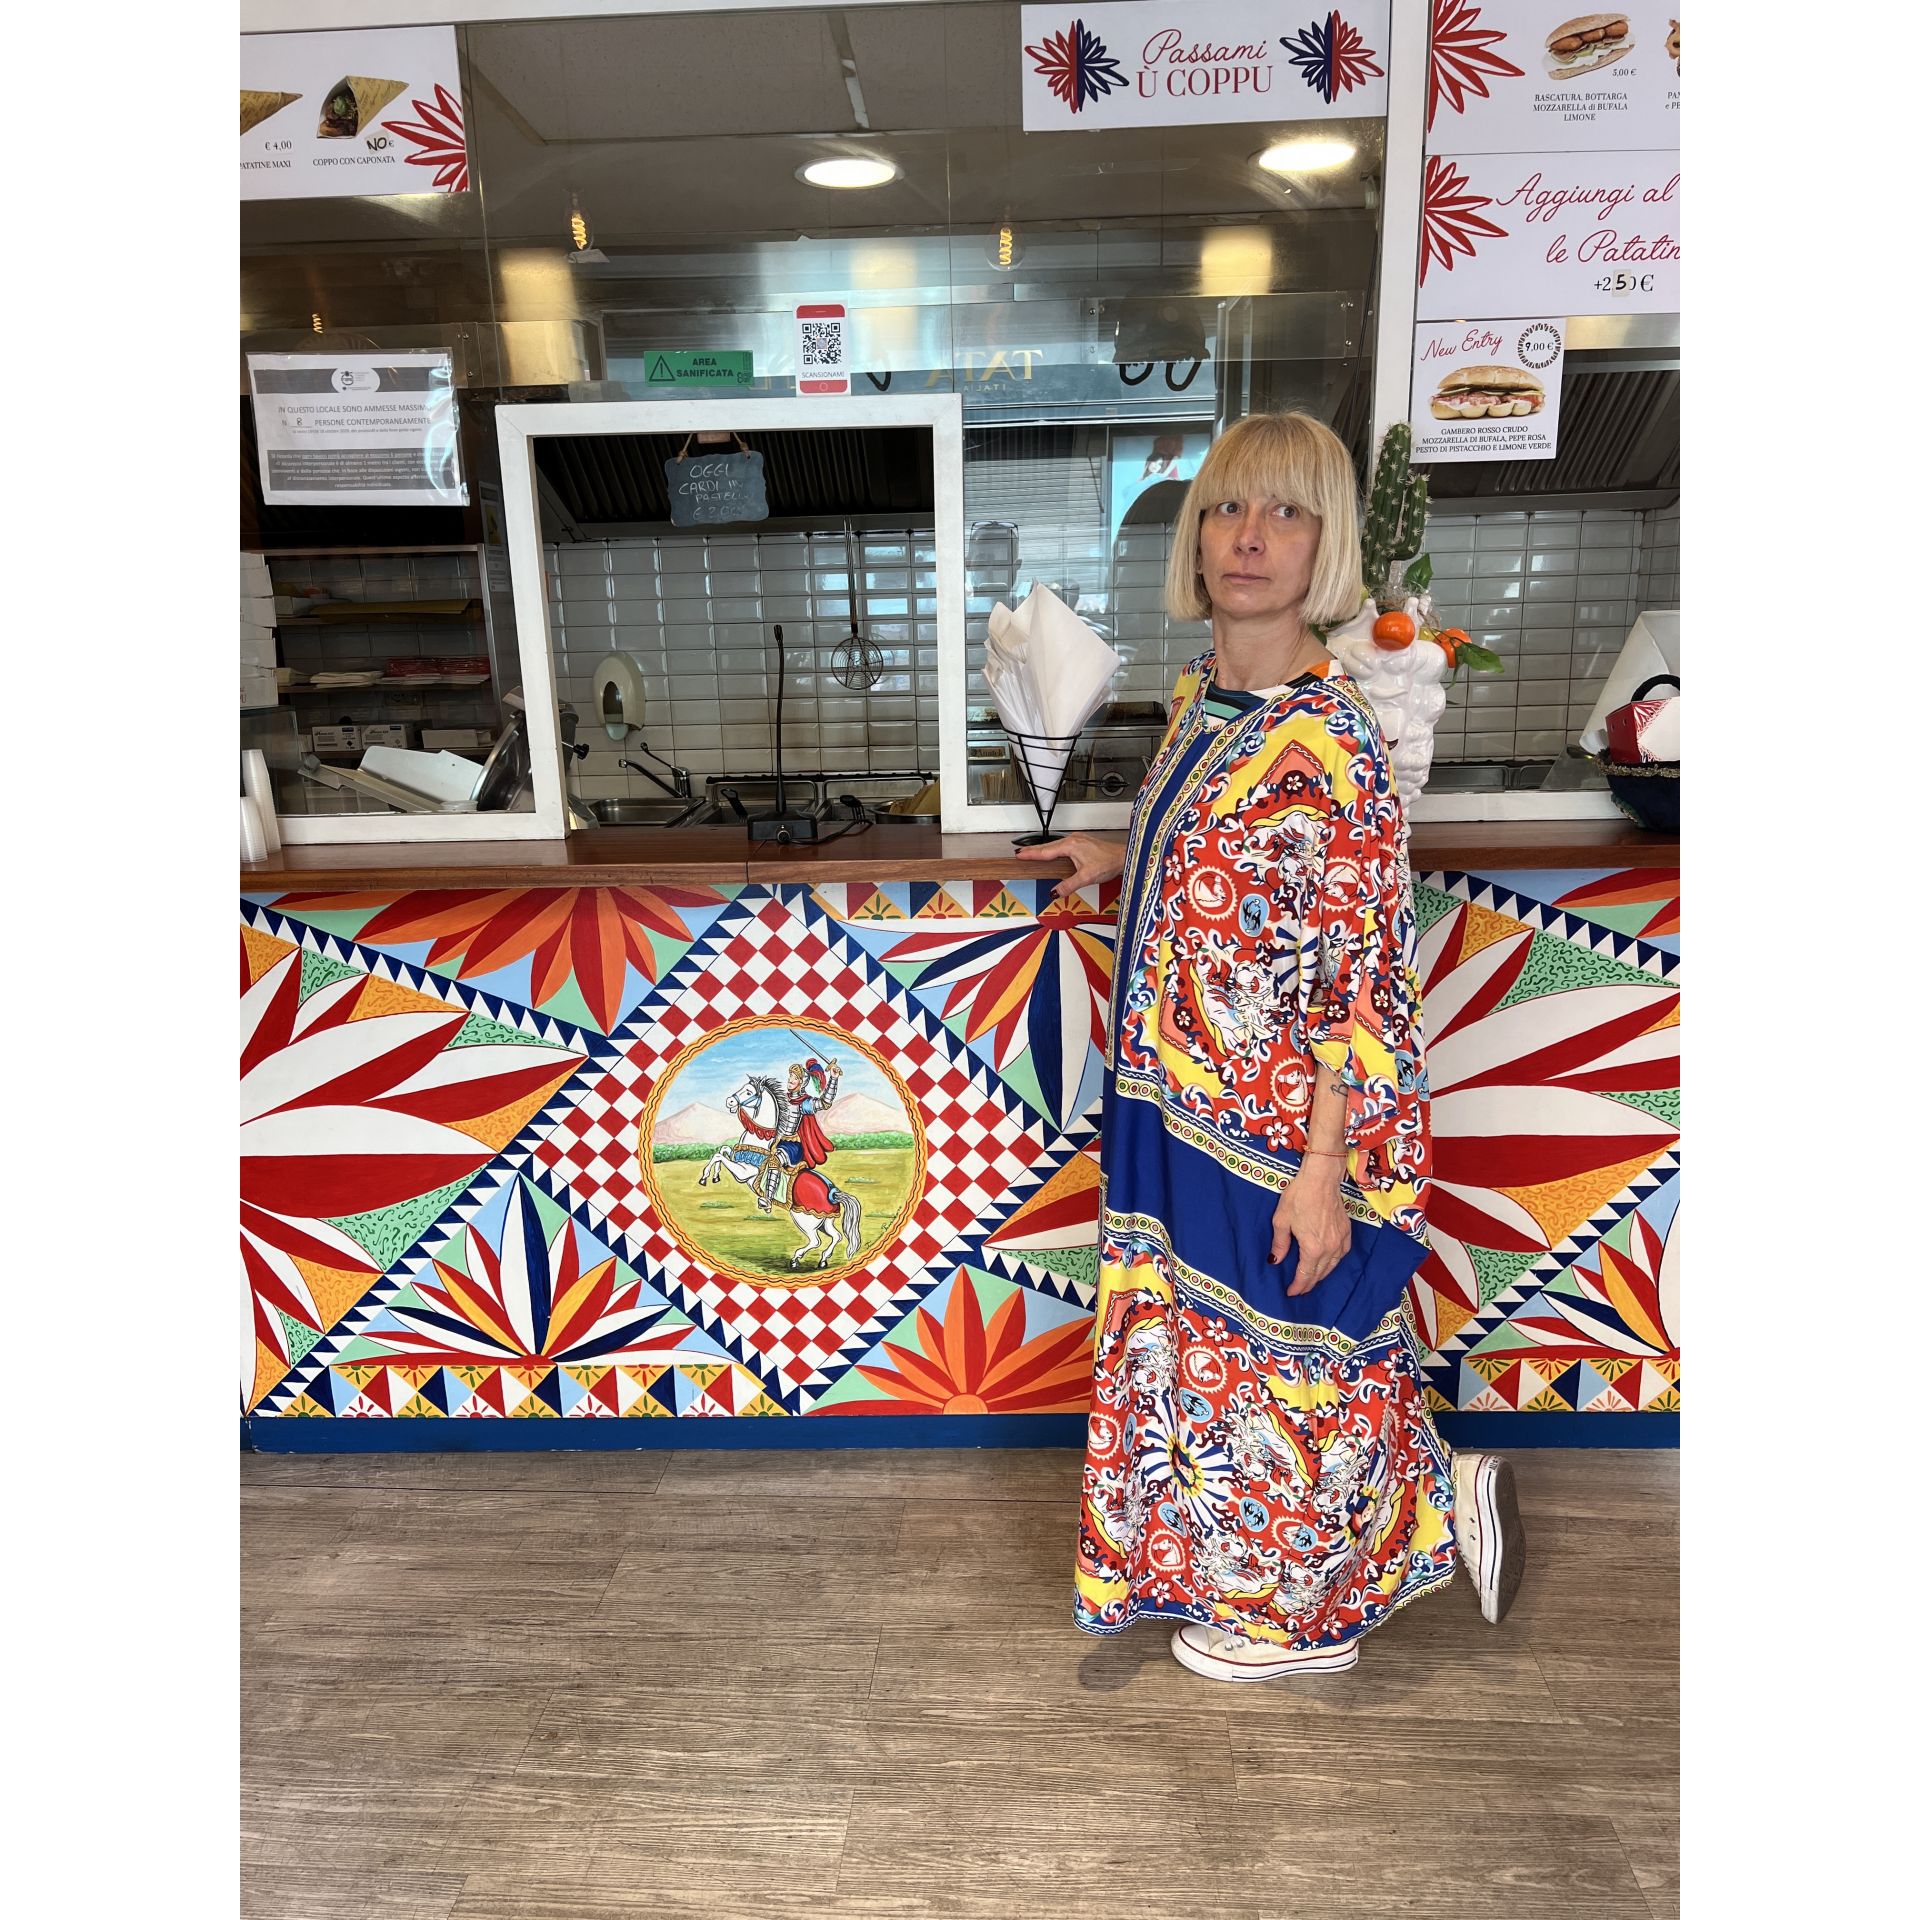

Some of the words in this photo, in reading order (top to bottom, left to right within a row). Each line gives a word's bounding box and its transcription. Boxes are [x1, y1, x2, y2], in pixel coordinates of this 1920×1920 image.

[1142, 28, 1267, 66] Passami
[1612, 68, 1629, 77] 5,00
[1136, 65, 1158, 98] Ù
[1166, 65, 1274, 97] COPPU
[1585, 92, 1628, 101] BOTTARGA
[1533, 104, 1587, 112] MOZZARELLA
[1588, 103, 1596, 111] di
[1597, 103, 1628, 111] BUFALA
[1563, 113, 1596, 122] LIMONE
[265, 141, 271, 151] €
[273, 140, 292, 151] 4,00
[366, 136, 387, 151] NO
[272, 160, 292, 169] MAXI
[312, 158, 338, 167] COPPO
[339, 157, 356, 166] CON
[357, 155, 396, 165] CAPONATA
[1496, 172, 1634, 223] Aggiungi
[1643, 173, 1680, 202] al
[1546, 234, 1569, 264] le
[1420, 338, 1457, 361] New
[1461, 328, 1504, 356] Entry
[1524, 341, 1545, 352] 9,00
[692, 357, 717, 366] AREA
[676, 368, 734, 378] SANIFICATA
[801, 371, 845, 379] SCANSIONAMI
[342, 405, 362, 413] SONO
[364, 404, 398, 412] AMMESSE
[346, 417, 432, 426] CONTEMPORANEAMENTE
[1441, 427, 1476, 435] GAMBERO
[1477, 426, 1501, 434] ROSSO
[1502, 425, 1529, 433] CRUDO
[1422, 436, 1469, 445] MOZZARELLA
[1508, 434, 1526, 442] PEPE
[1415, 446, 1439, 454] PESTO
[1440, 445, 1448, 453] DI
[1449, 444, 1492, 453] PISTACCHIO
[1499, 443, 1527, 451] LIMONE
[1528, 442, 1552, 450] VERDE
[689, 463, 729, 478] OGGI
[678, 480, 719, 495] CARDI
